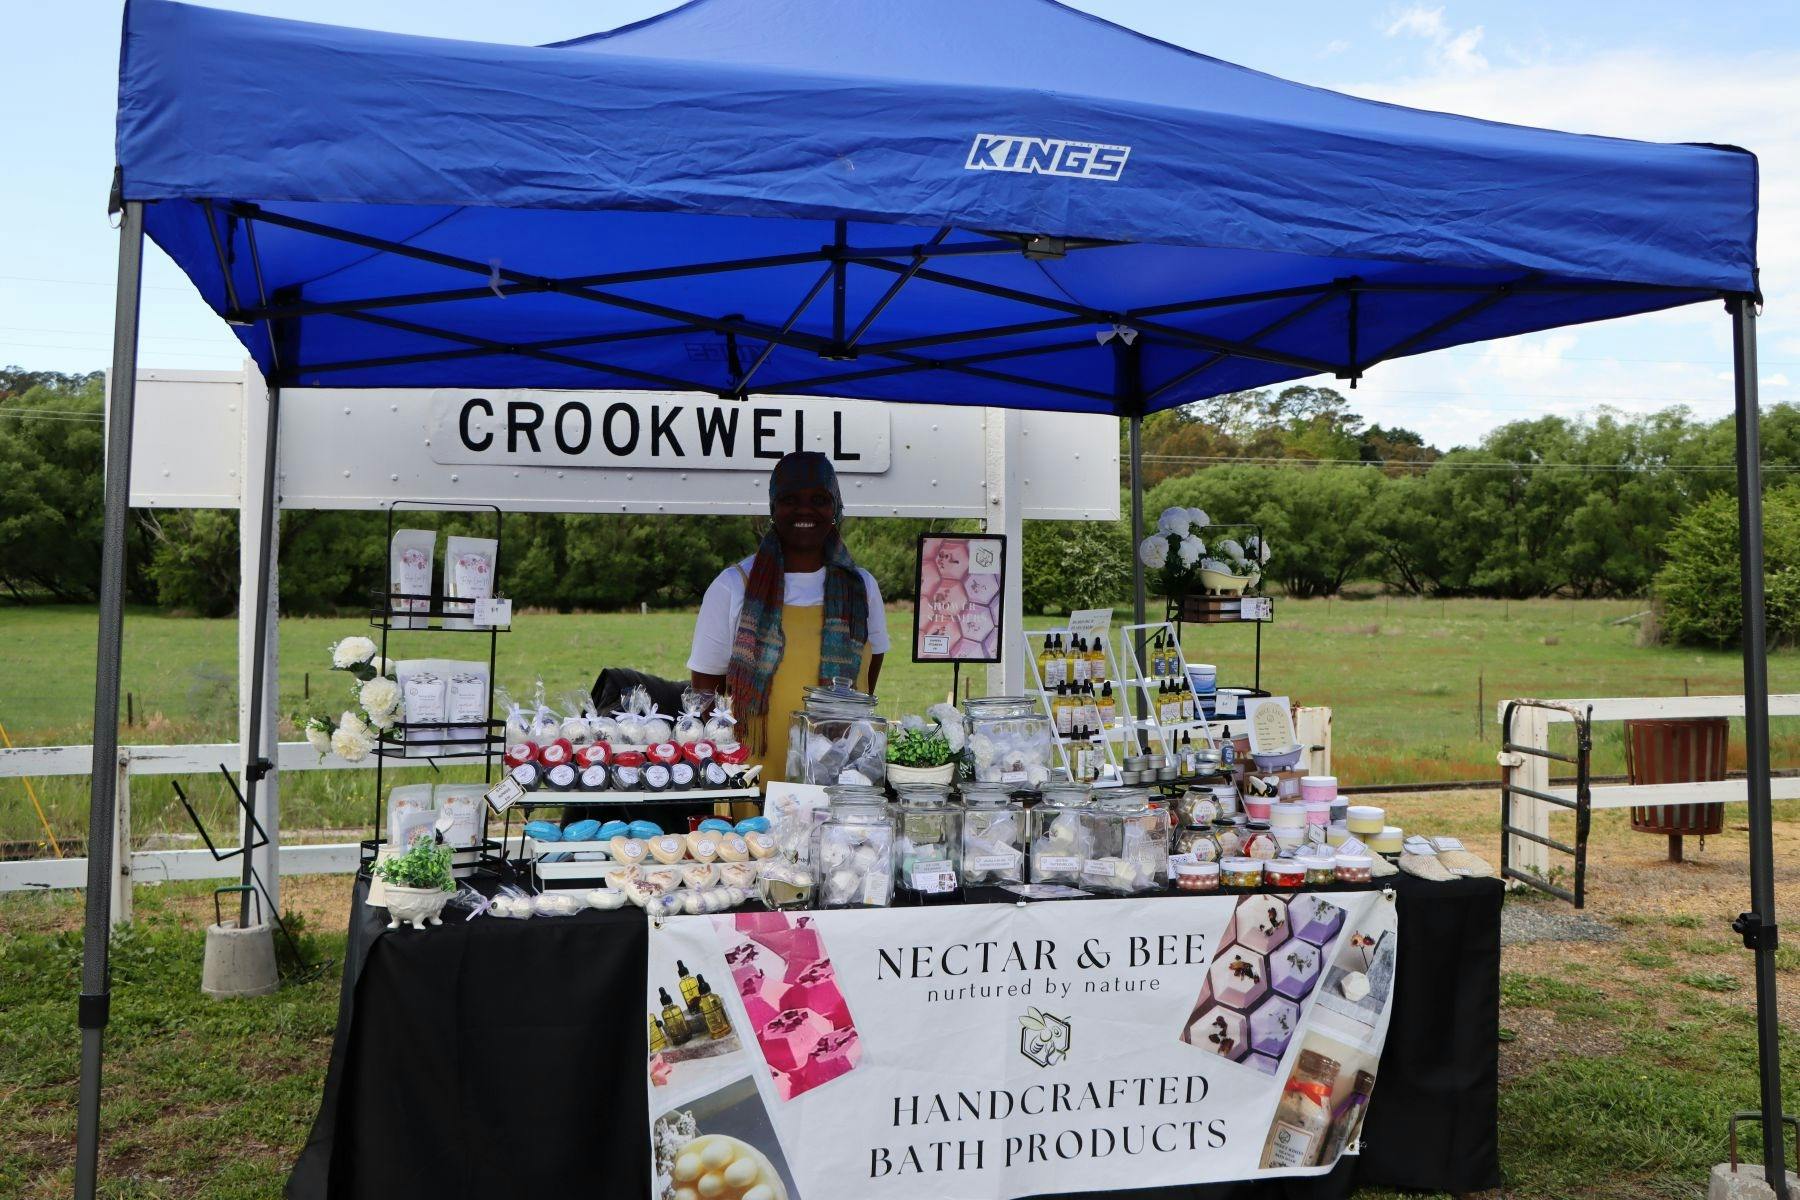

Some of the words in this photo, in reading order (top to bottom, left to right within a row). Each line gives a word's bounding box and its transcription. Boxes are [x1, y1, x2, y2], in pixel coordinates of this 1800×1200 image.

[965, 134, 1131, 181] KINGS
[459, 398, 860, 460] CROOKWELL
[877, 939, 1058, 980] NECTAR
[1077, 938, 1111, 969] &
[1129, 934, 1205, 967] BEE
[928, 978, 1031, 1002] nurtured
[1045, 978, 1071, 998] by
[1085, 977, 1161, 993] nature
[892, 1075, 1209, 1126] HANDCRAFTED
[870, 1140, 984, 1178] BATH
[1005, 1119, 1227, 1168] PRODUCTS
